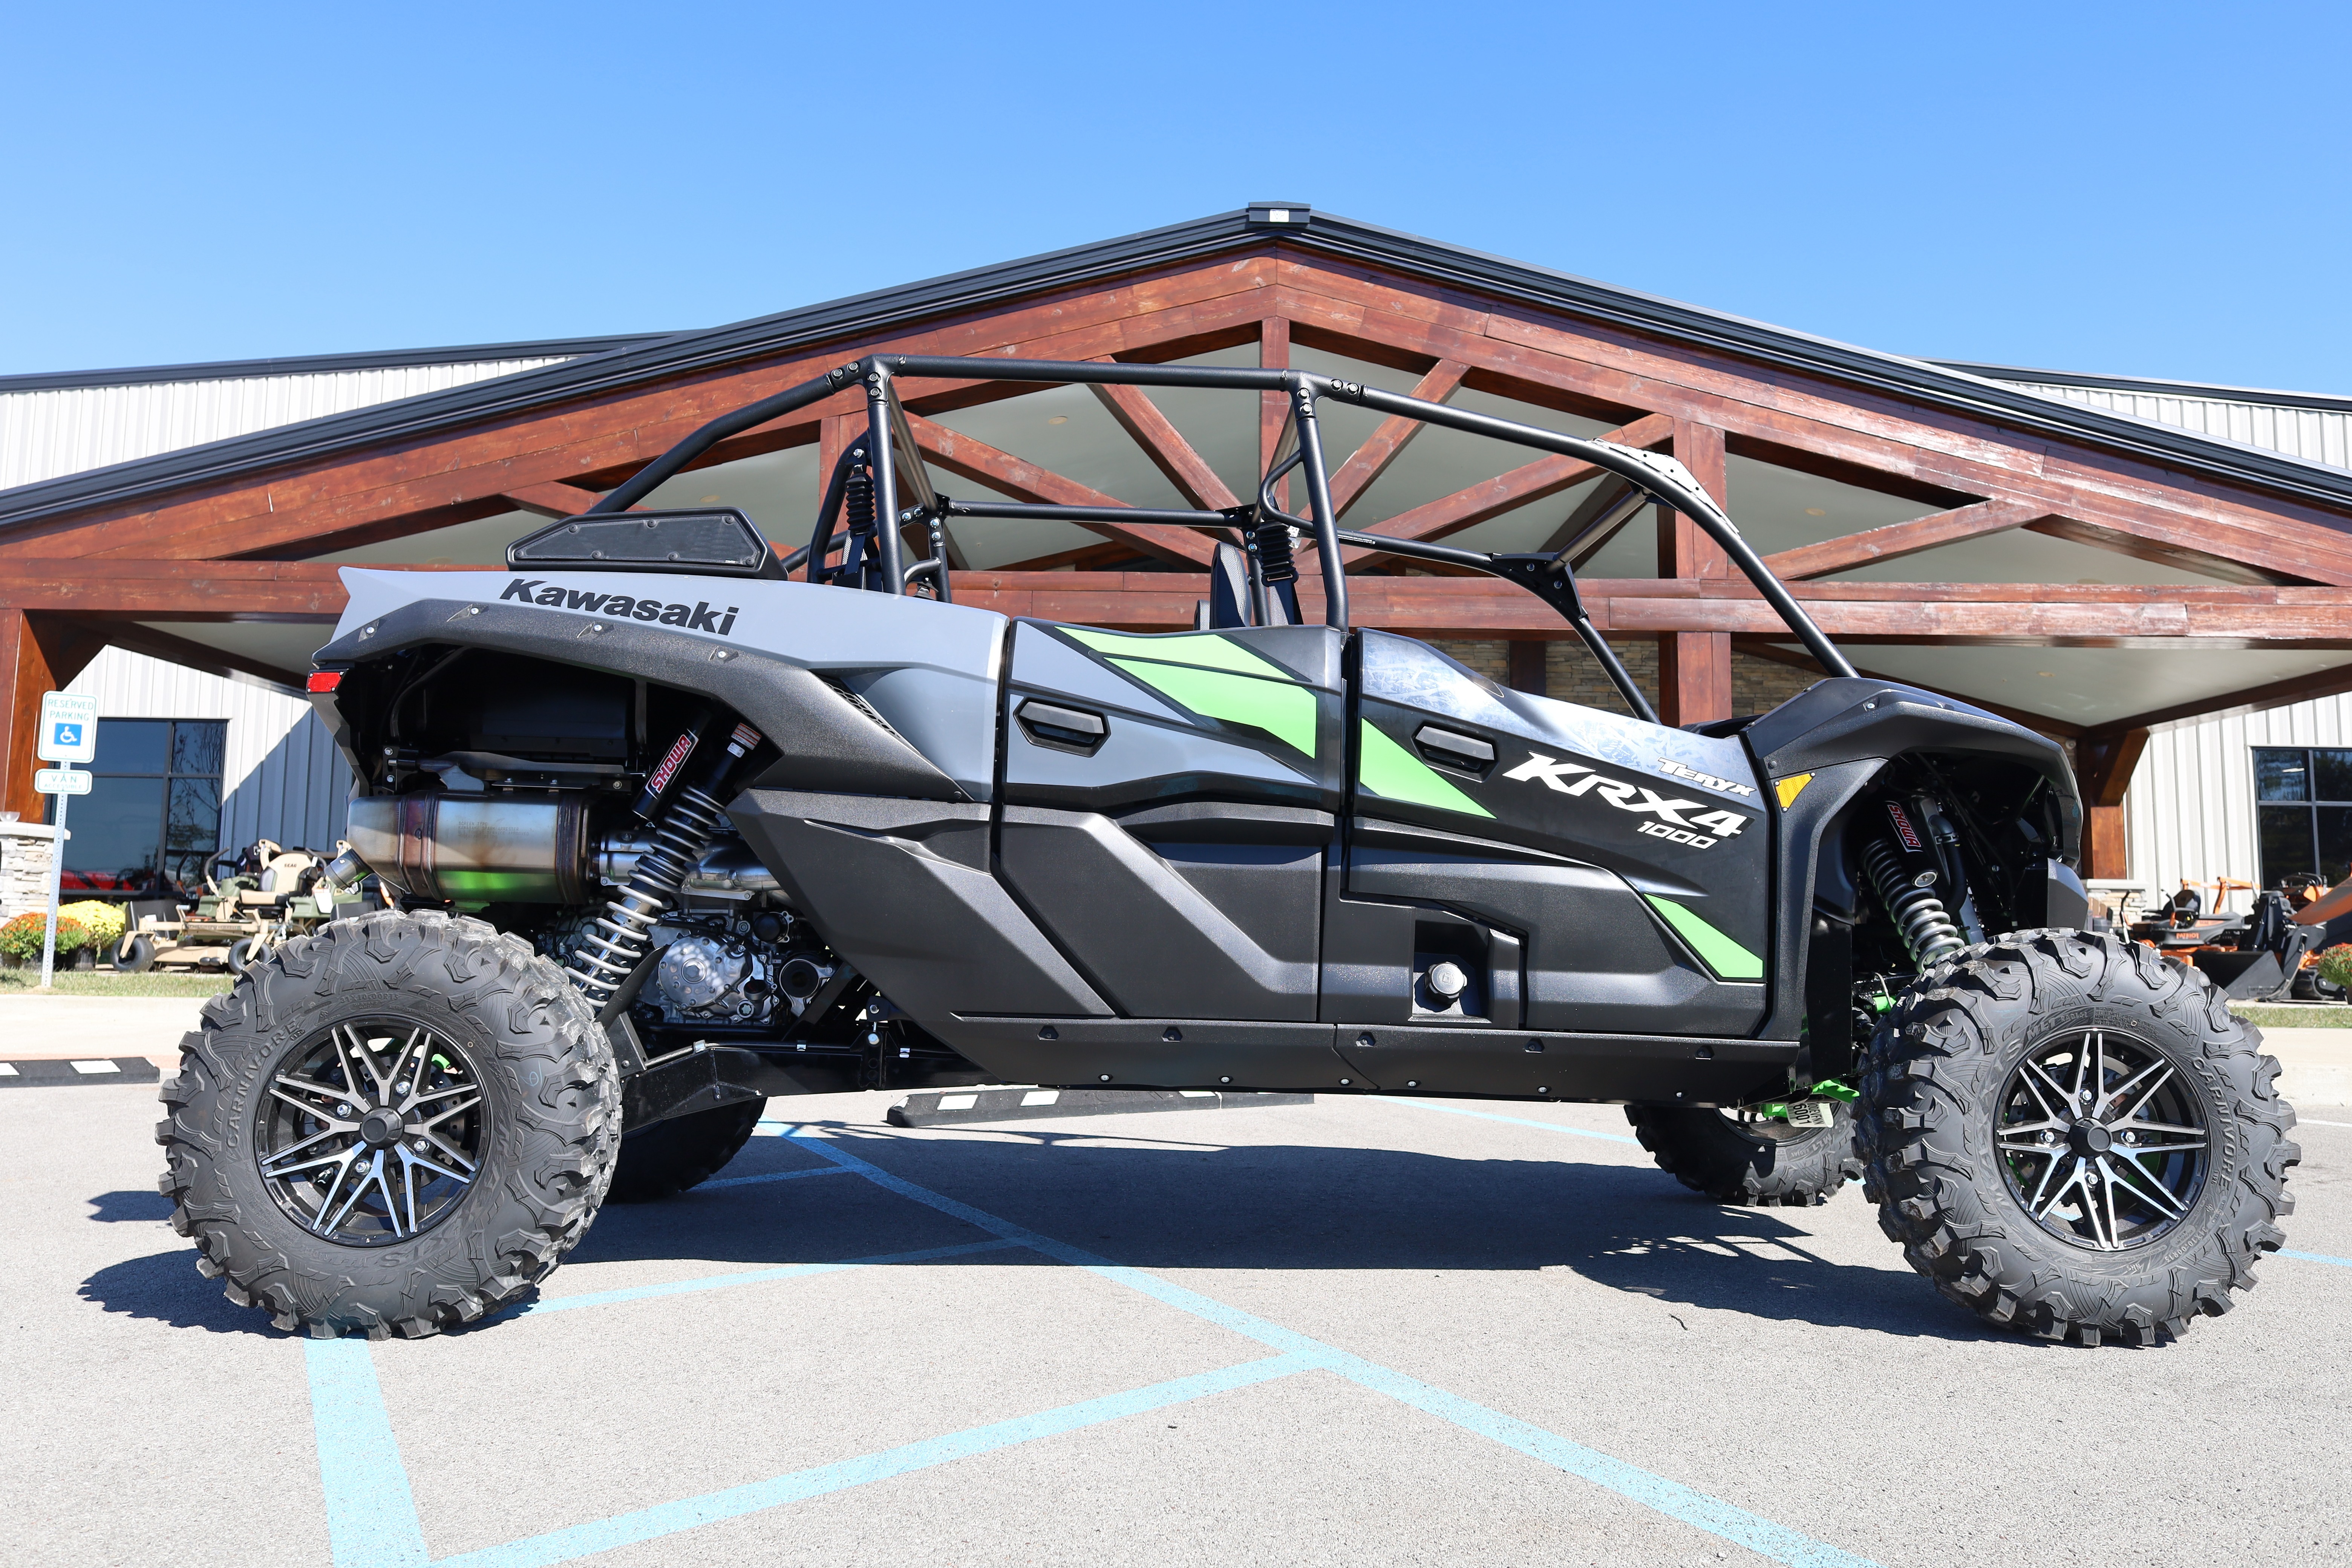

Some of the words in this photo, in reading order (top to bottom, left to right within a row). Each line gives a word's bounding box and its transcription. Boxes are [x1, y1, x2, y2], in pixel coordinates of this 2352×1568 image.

[499, 579, 739, 635] Kawasaki
[48, 699, 93, 710] RESERVED
[50, 711, 89, 721] PARKING
[651, 734, 692, 794] SHOWA
[1658, 757, 1757, 797] TERYX
[1502, 750, 1747, 837] KRX4
[1637, 821, 1718, 849] 1000
[1887, 805, 1921, 847] SHOWA
[227, 1018, 300, 1147] CARNIVORE
[1793, 1104, 1812, 1124] 6001
[2193, 1057, 2235, 1189] CARNIVORE
